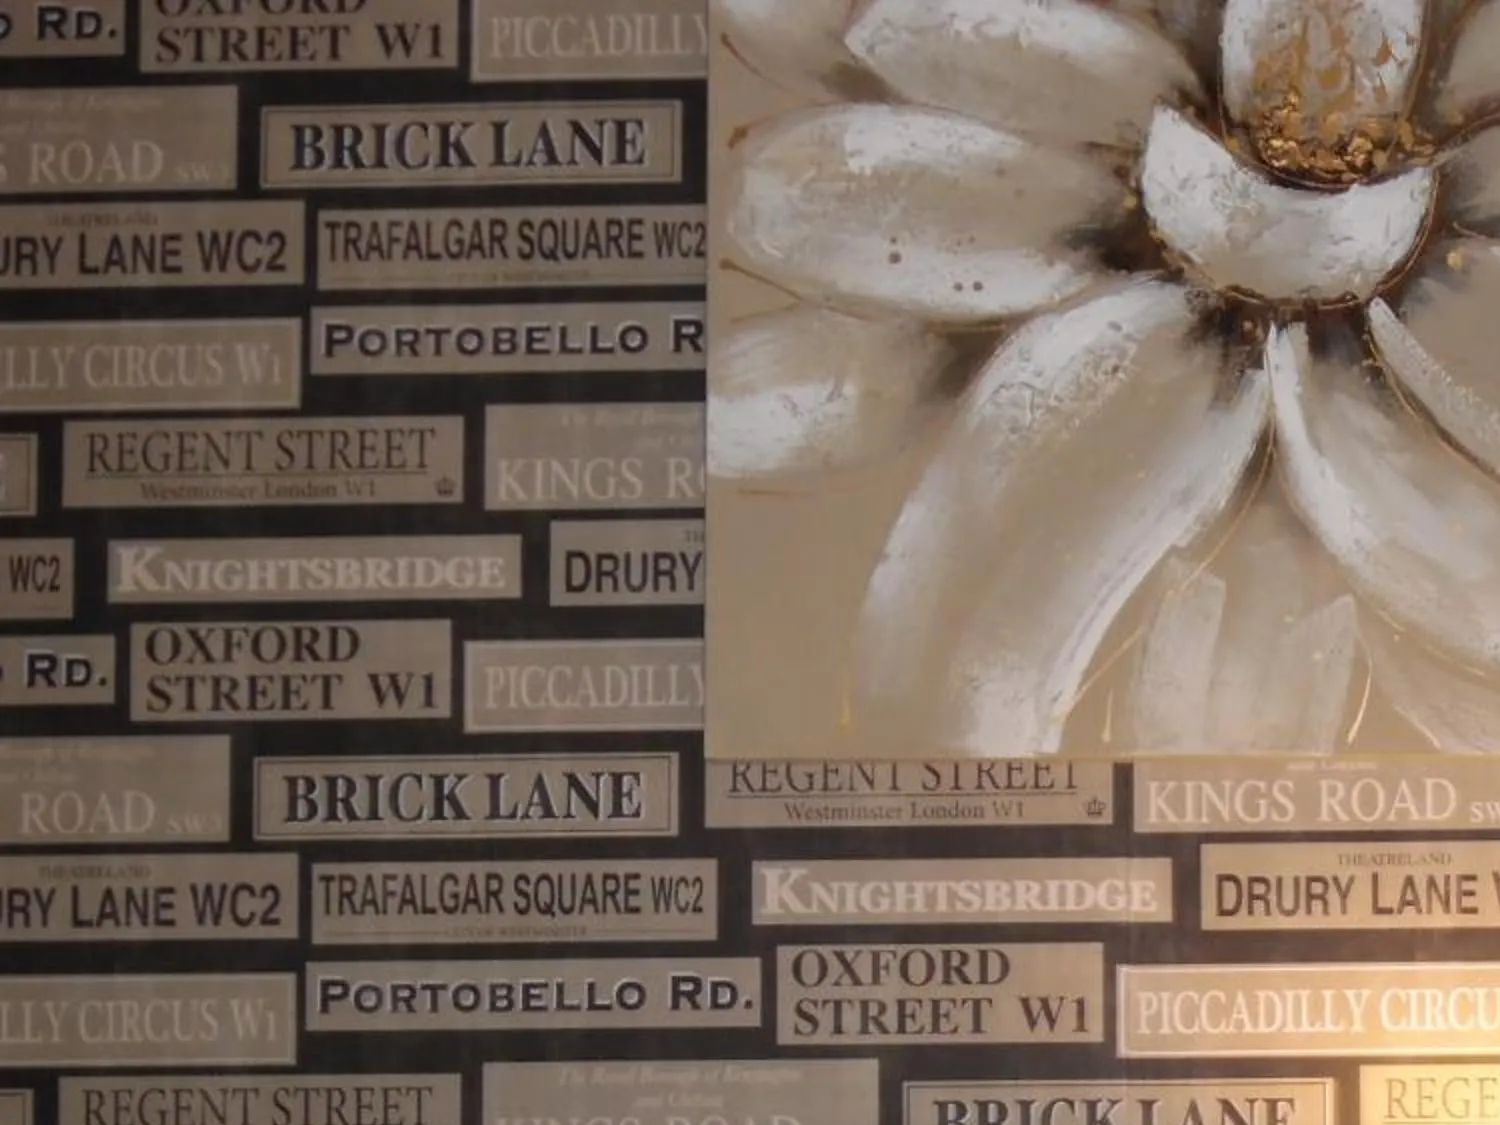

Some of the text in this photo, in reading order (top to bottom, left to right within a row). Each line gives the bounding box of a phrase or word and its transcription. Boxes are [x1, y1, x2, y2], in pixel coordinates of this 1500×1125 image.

[37, 6, 116, 40] RD.
[155, 23, 446, 63] STREET W1
[28, 140, 164, 185] ROAD
[289, 117, 646, 172] BRICK LANE
[78, 232, 184, 276] LANE
[196, 229, 287, 273] WC2
[325, 218, 706, 263] TRAFALGAR SQUARE WC2
[324, 322, 649, 358] PORTOBELLO
[84, 341, 224, 388] CIRCUS
[86, 428, 437, 473] REGENT STREET
[264, 480, 337, 500] London
[498, 456, 644, 501] KINGS
[9, 554, 61, 593] WC2
[115, 544, 505, 594] KNIGHTSBRIDGE
[564, 550, 703, 593] DRURY
[144, 625, 360, 666] OXFORD
[26, 652, 107, 689] RD.
[146, 672, 438, 714] STREET W1
[21, 789, 155, 836] ROAD
[283, 770, 642, 824] BRICK LANE
[784, 801, 903, 822] Westminster
[911, 800, 985, 821] London
[1147, 778, 1296, 825] KINGS
[1317, 776, 1457, 824] ROAD
[1337, 852, 1452, 867] THEATRELAND
[71, 884, 177, 929] LANE
[190, 882, 281, 927] WC2
[319, 872, 704, 918] TRAFALGAR SQUARE WC2
[760, 867, 1157, 915] KNIGHTSBRIDGE
[1215, 873, 1355, 918] DRURY
[1371, 871, 1479, 916] LANE
[791, 947, 1011, 988] OXFORD
[319, 973, 753, 1014] PORTOBELLO RD.
[792, 995, 1089, 1036] STREET W1
[1138, 988, 1370, 1035] PICCADILLY
[78, 998, 218, 1044] CIRCUS
